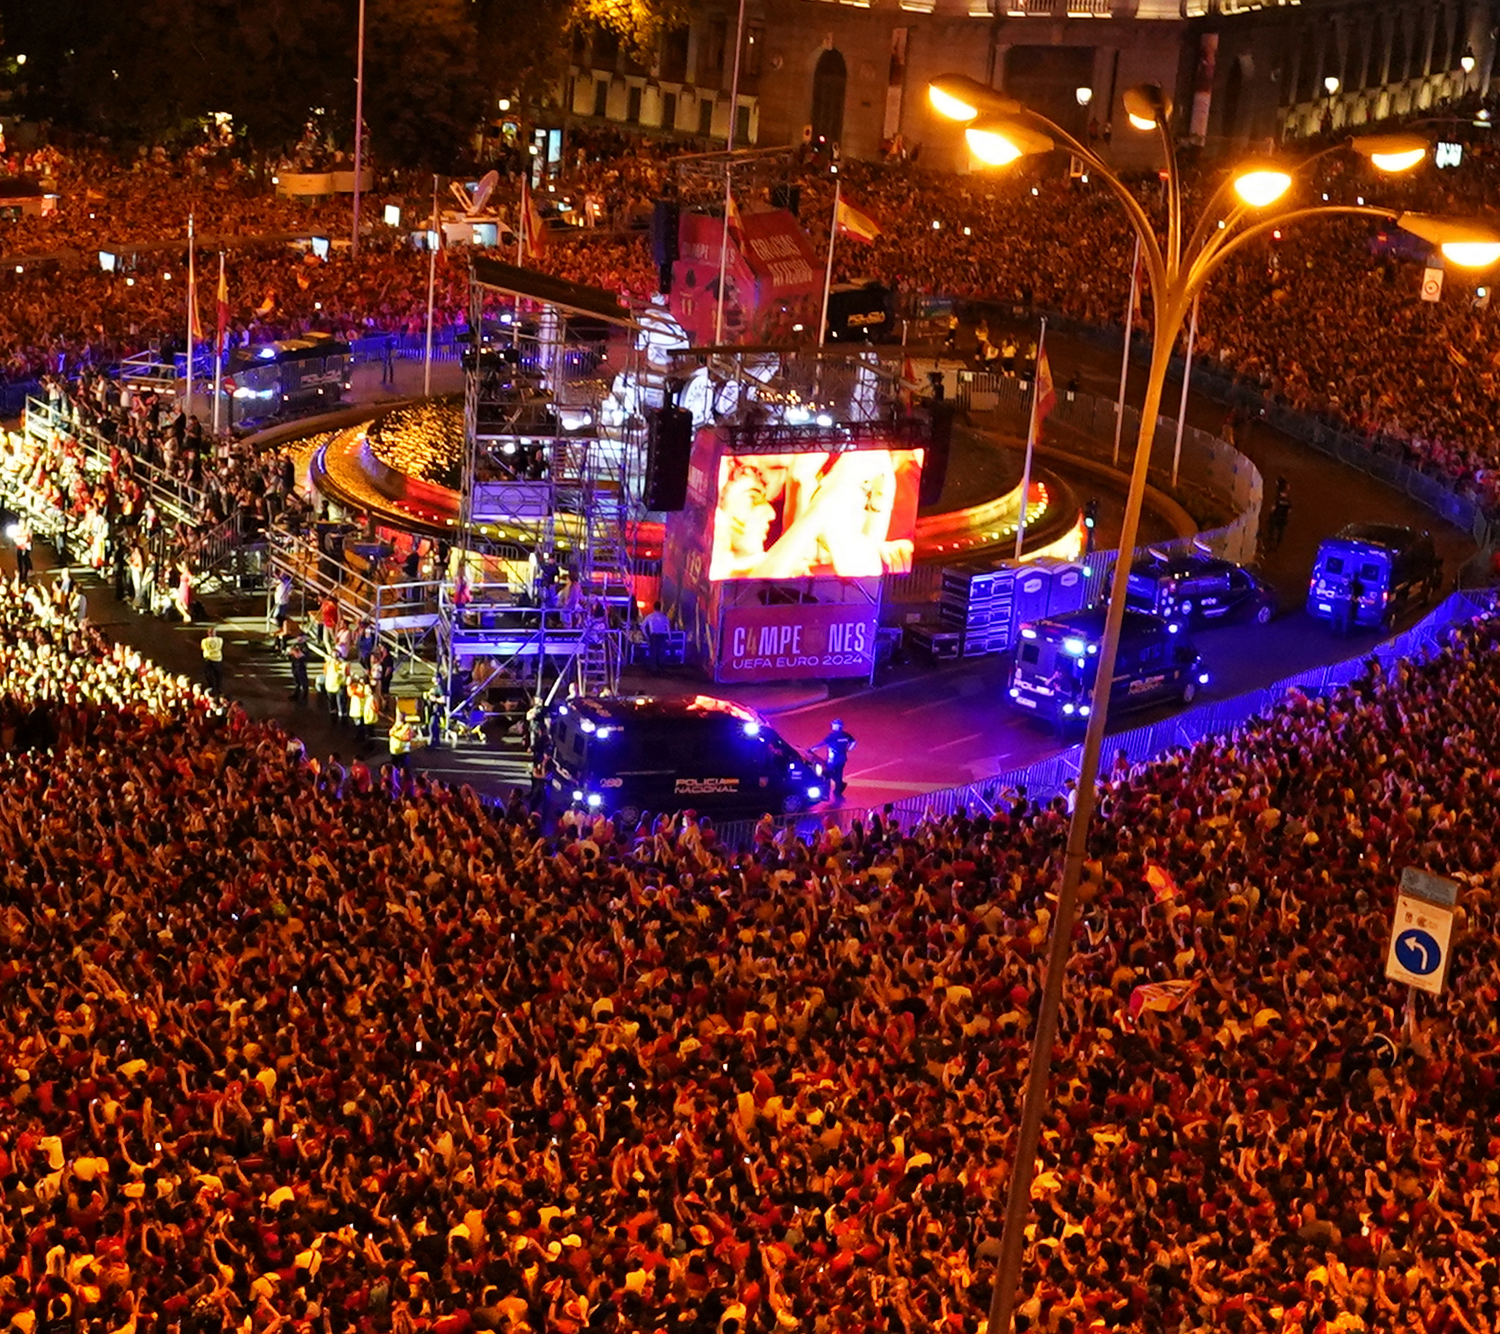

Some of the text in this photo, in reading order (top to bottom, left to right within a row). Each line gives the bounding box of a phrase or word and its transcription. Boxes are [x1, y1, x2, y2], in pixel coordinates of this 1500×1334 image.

[733, 622, 866, 657] C4MPE NES
[733, 654, 862, 669] UEFA EURO 2024
[675, 777, 724, 786] POLICIA
[674, 784, 738, 794] NACIONAL
